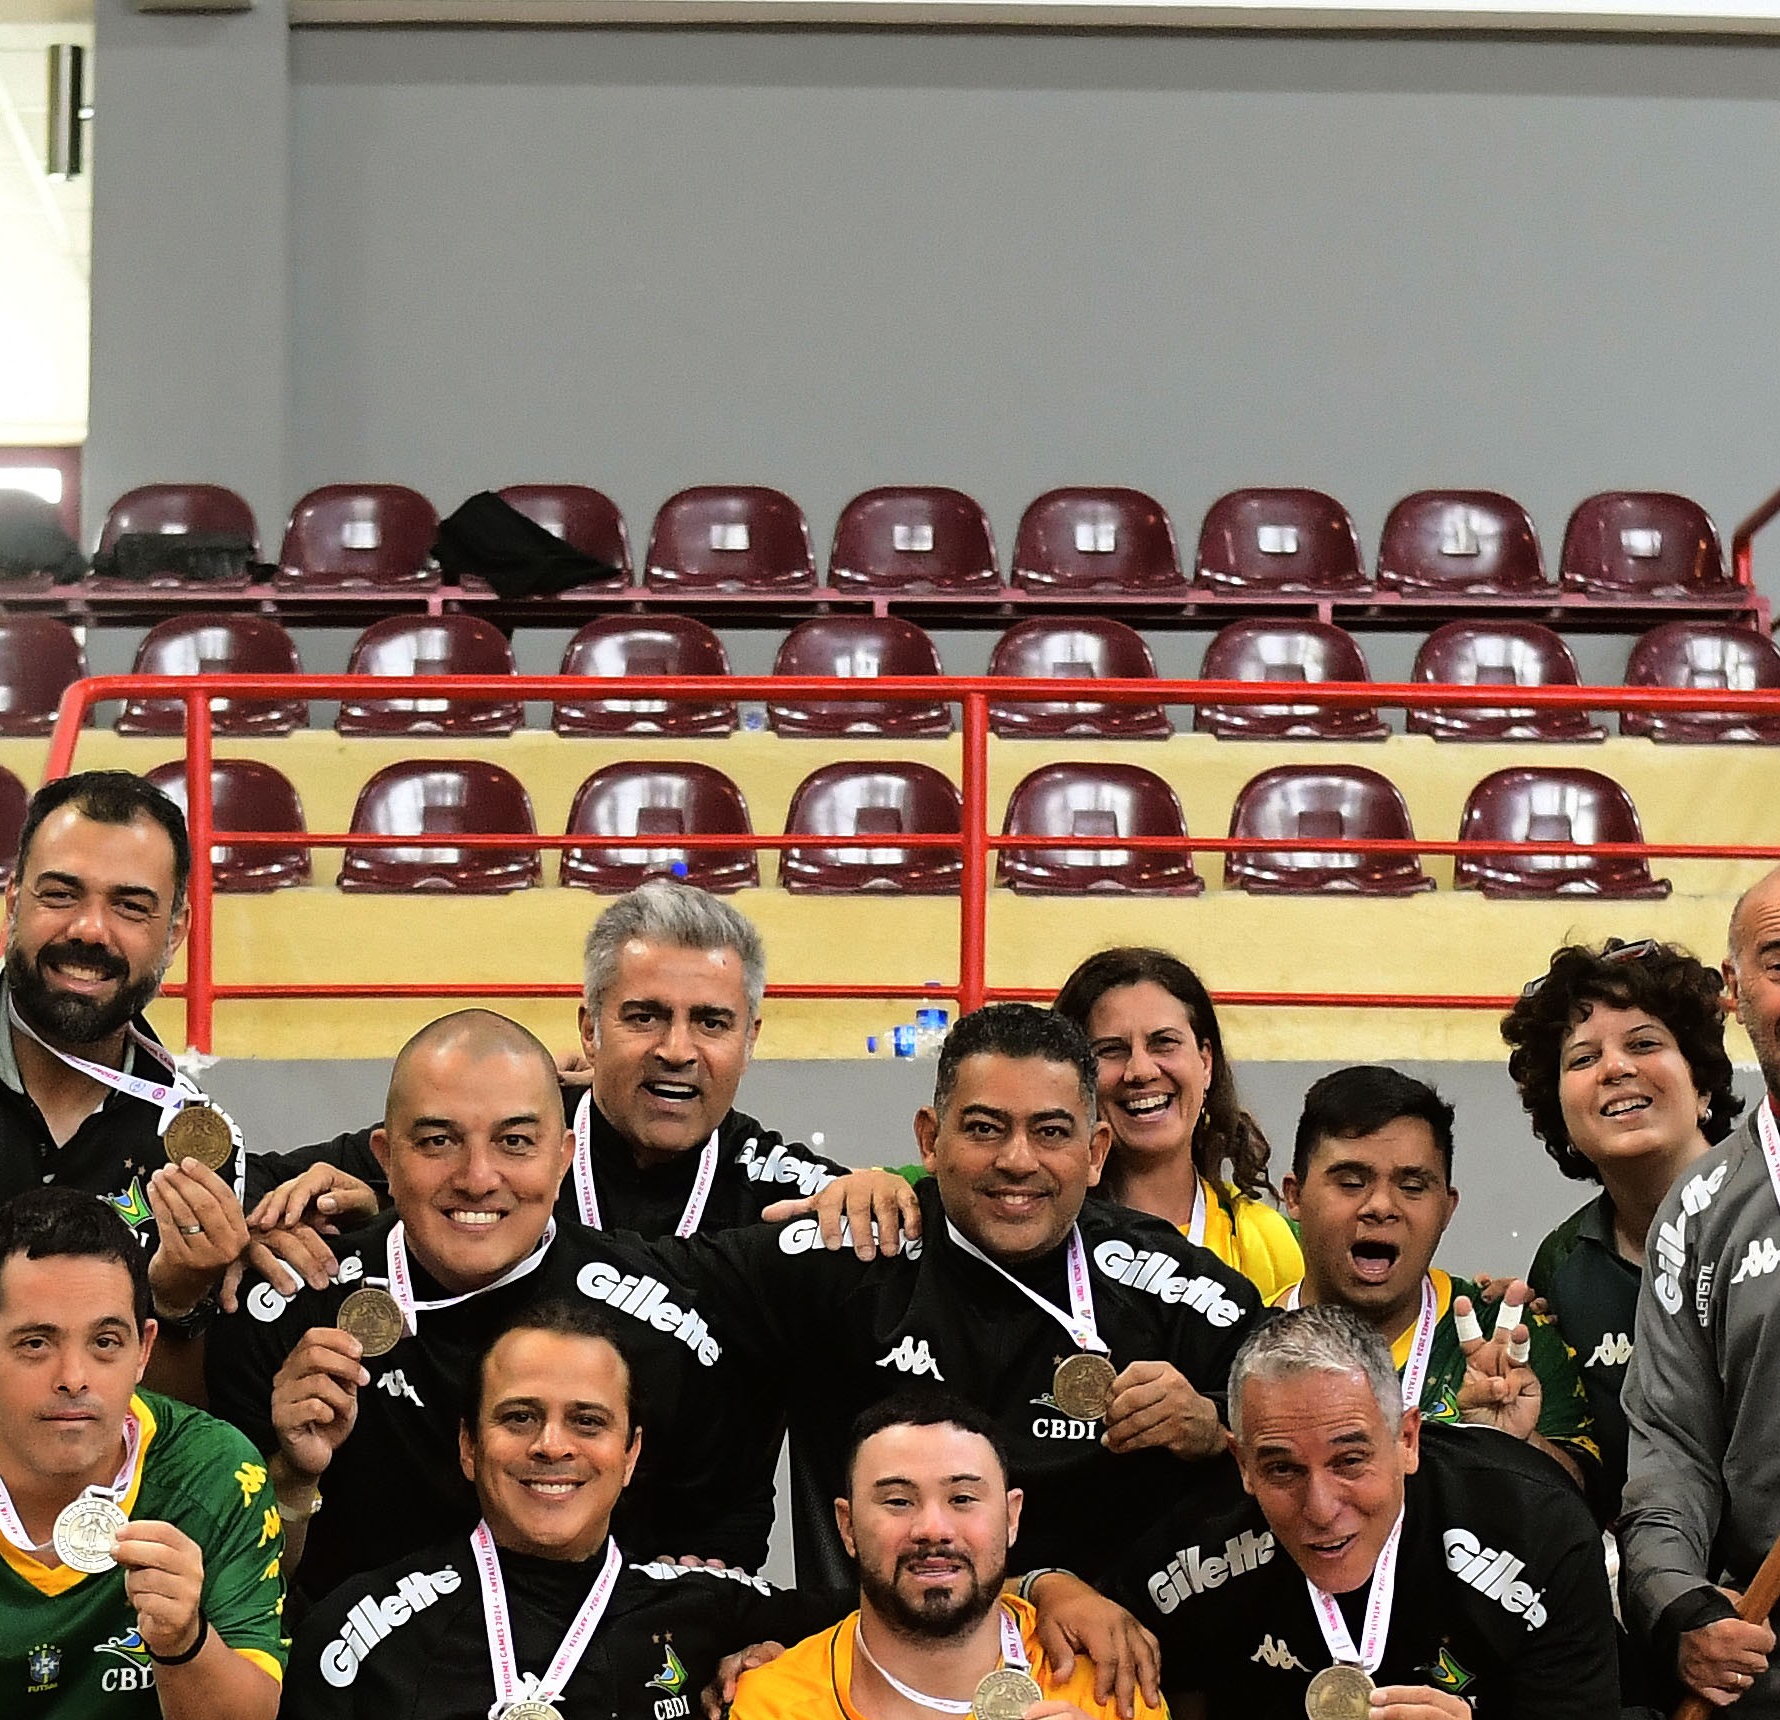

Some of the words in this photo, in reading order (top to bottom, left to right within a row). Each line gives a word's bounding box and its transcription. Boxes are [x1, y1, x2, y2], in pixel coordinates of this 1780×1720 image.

[1094, 1240, 1240, 1328] Gillette
[576, 1262, 721, 1366] Gillette
[1404, 1364, 1419, 1400] ANTALYA
[1032, 1419, 1097, 1440] CBDI
[484, 1556, 498, 1594] ANTALYA
[320, 1570, 462, 1687] Gillette
[493, 1604, 503, 1626] 2024
[496, 1627, 507, 1658] GAMES
[501, 1660, 513, 1698] TRISOME
[654, 1695, 690, 1720] CBDI
